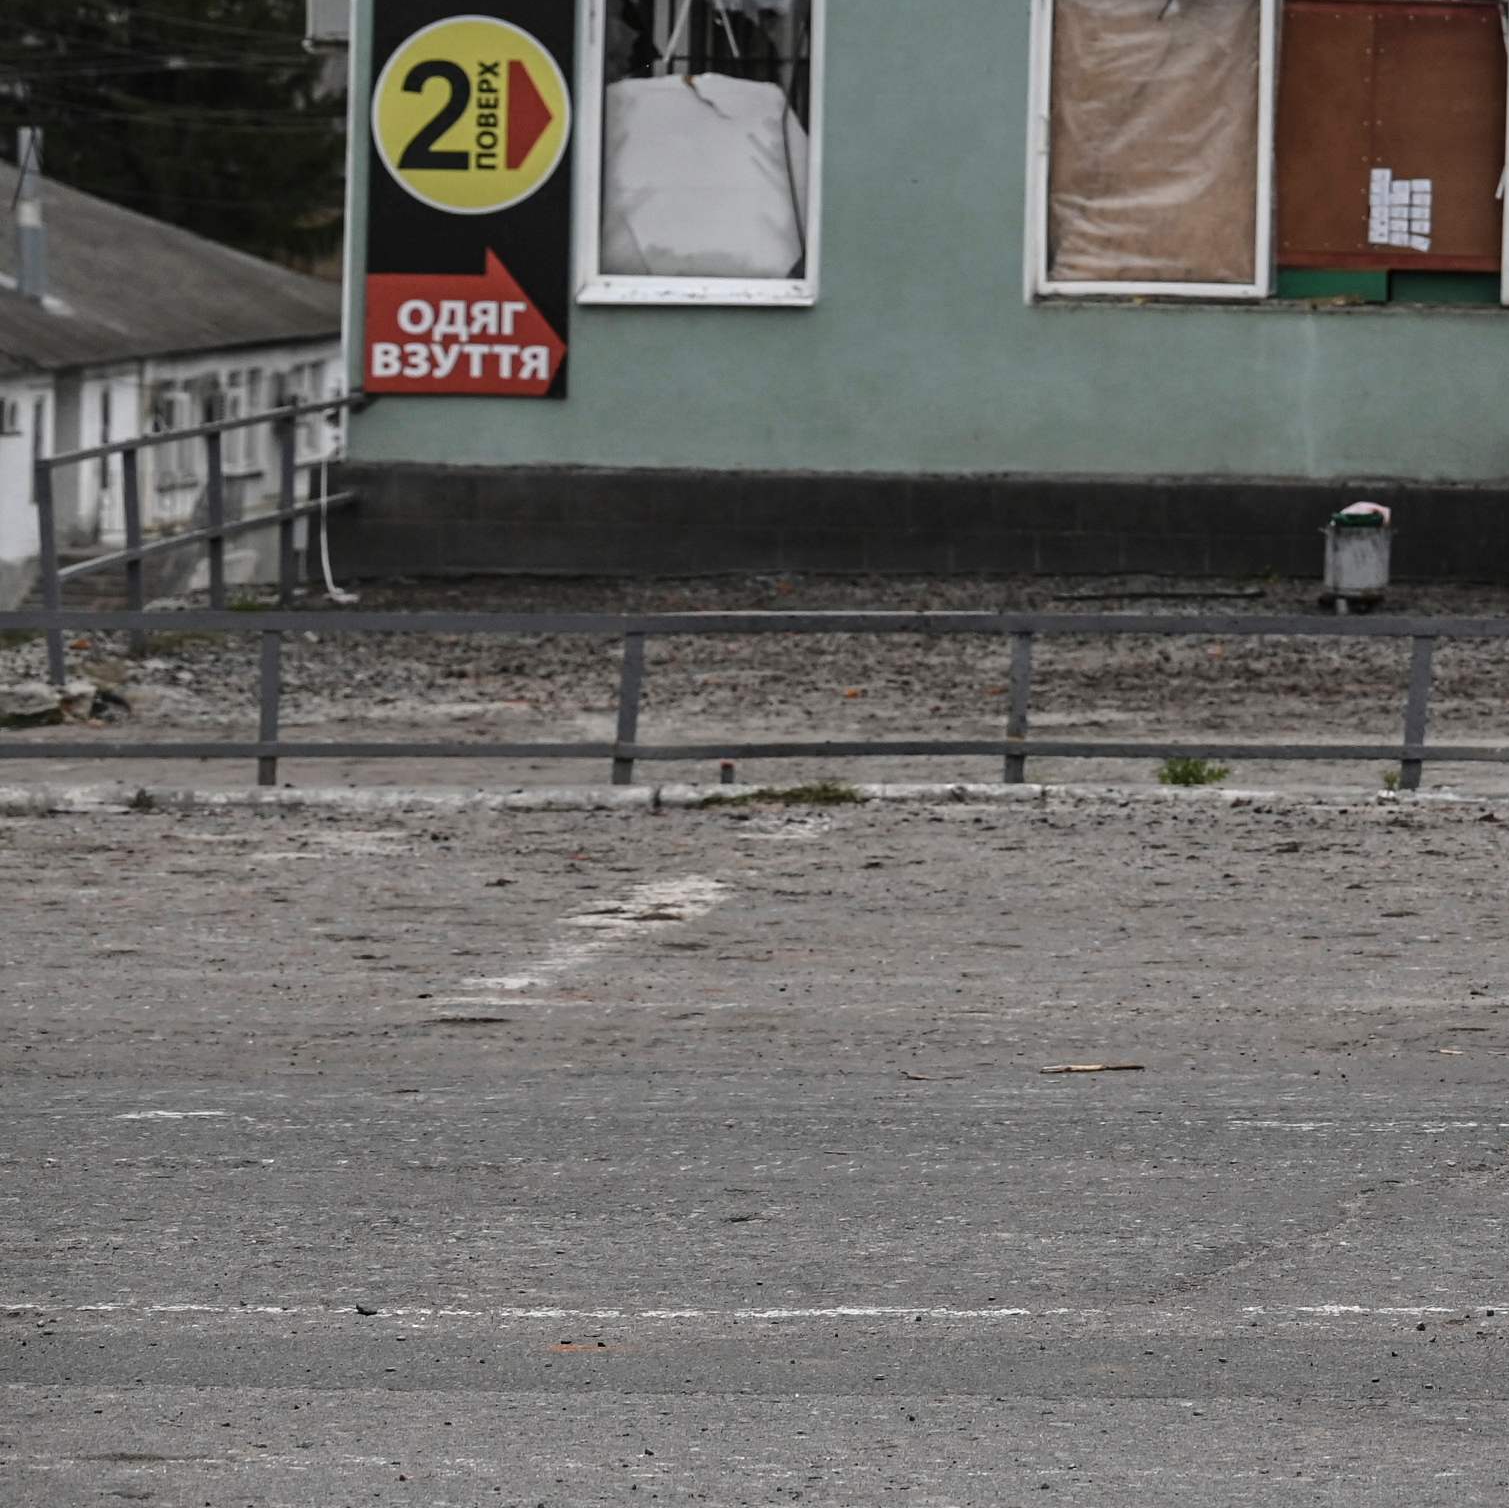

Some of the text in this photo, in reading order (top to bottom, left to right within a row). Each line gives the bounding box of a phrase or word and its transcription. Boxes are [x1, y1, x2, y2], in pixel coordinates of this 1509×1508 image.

[398, 59, 501, 171] 2 ПОВЕРХ
[397, 299, 526, 344] ОДЯГ
[371, 343, 550, 380] ВЗУТТЯ
